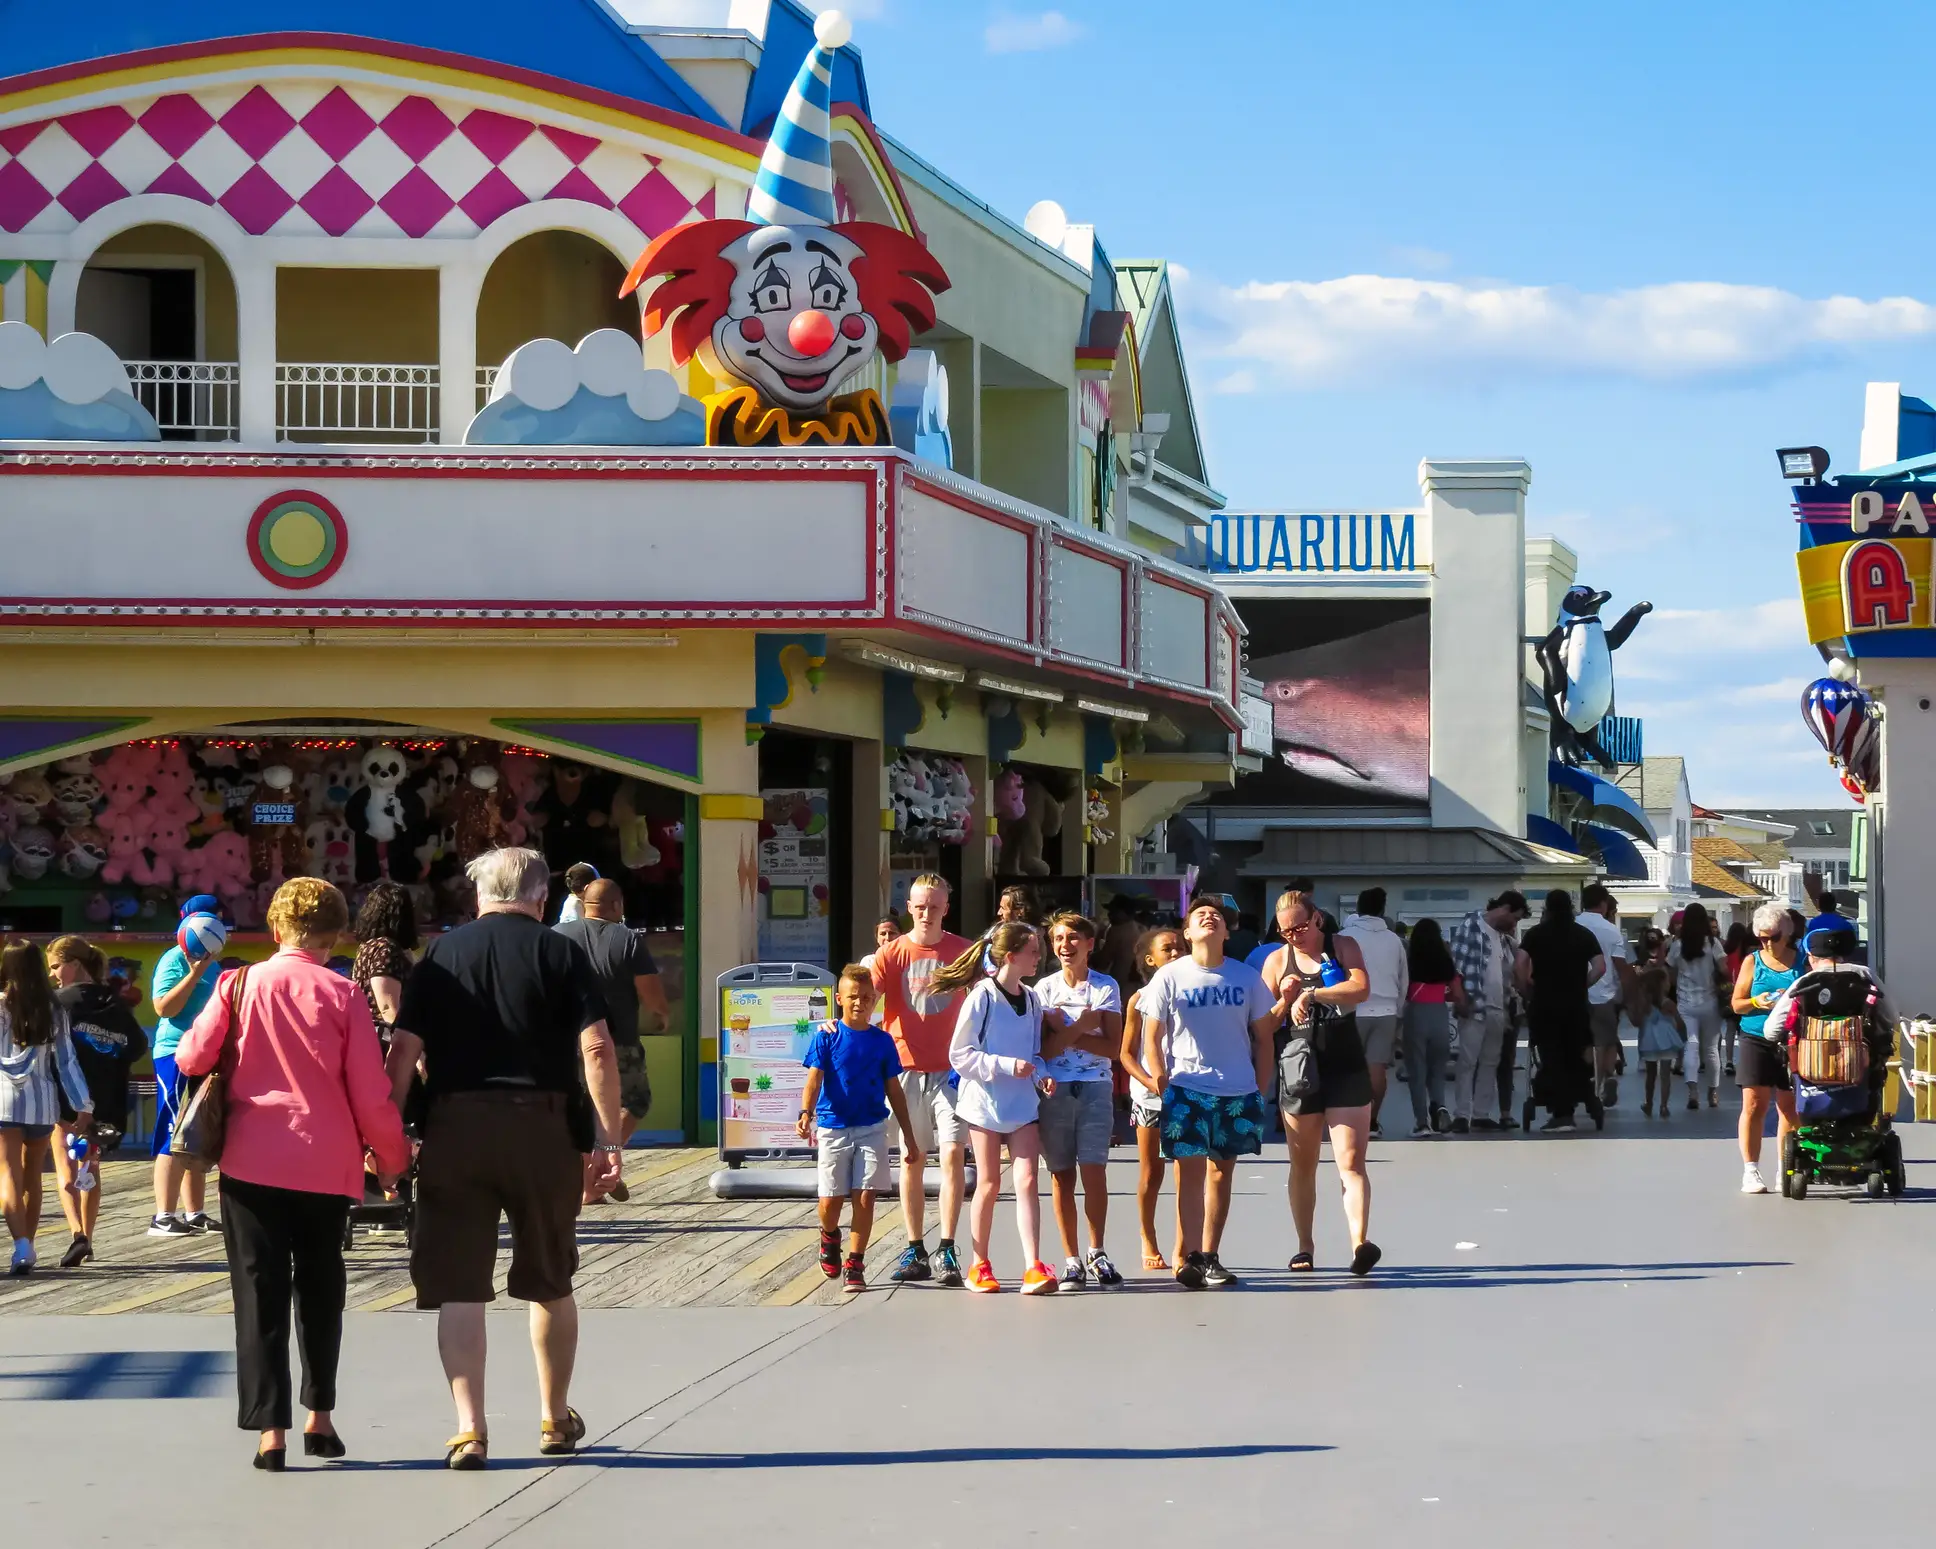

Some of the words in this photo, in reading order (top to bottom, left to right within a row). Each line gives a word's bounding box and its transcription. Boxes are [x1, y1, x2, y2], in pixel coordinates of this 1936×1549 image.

[1851, 491, 1936, 533] PA
[1840, 538, 1936, 633] A
[254, 804, 294, 813] CHOICE
[254, 814, 294, 823] PRIZE
[1182, 984, 1245, 1007] WMC
